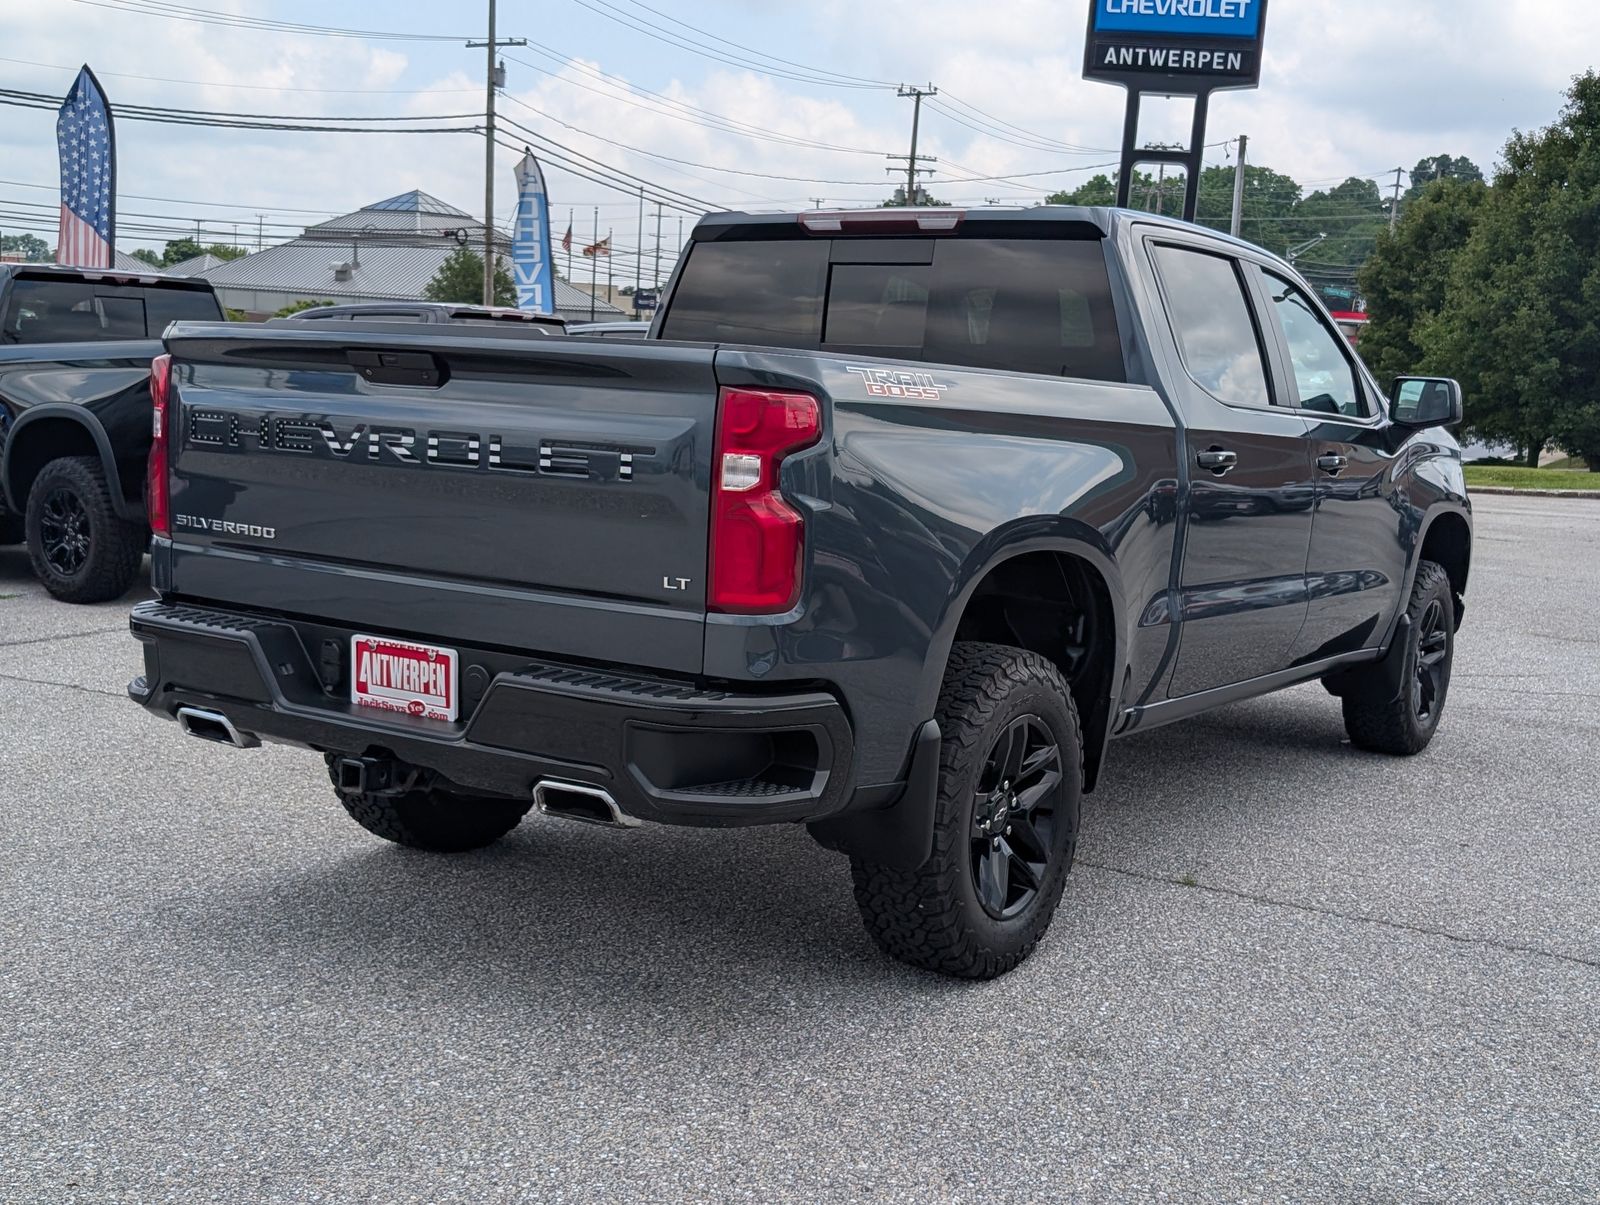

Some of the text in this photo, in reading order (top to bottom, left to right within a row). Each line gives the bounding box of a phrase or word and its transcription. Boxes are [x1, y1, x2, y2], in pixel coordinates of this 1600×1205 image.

[1105, 0, 1250, 18] CHEVROLET
[1104, 47, 1242, 70] ANTWERPEN
[846, 366, 947, 390] TRAIL
[866, 383, 940, 400] BOSS
[189, 411, 656, 482] CHEVROLET
[176, 514, 276, 539] SILVERADO
[663, 576, 691, 590] LT
[364, 639, 440, 654] ANTWERPEN
[360, 651, 446, 699] ANTWERPEN
